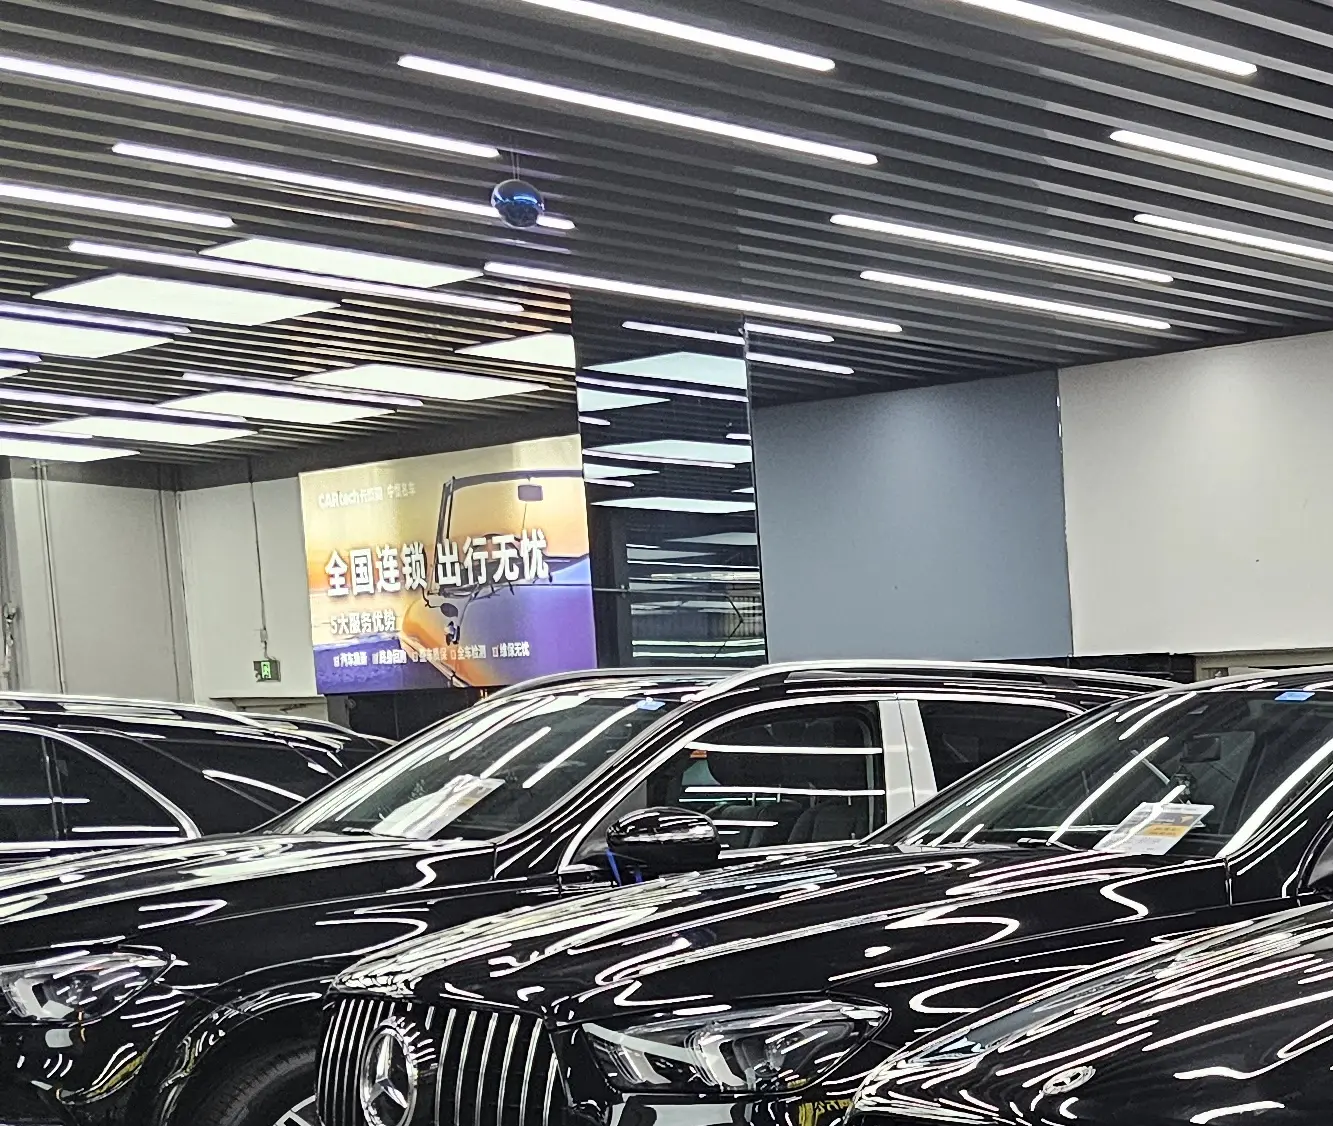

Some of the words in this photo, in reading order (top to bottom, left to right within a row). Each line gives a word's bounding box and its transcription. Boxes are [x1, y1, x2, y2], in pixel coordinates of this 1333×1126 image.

[324, 542, 428, 598] 全国连锁
[434, 528, 549, 588] 出行无忧
[330, 609, 397, 635] 5大服务优势
